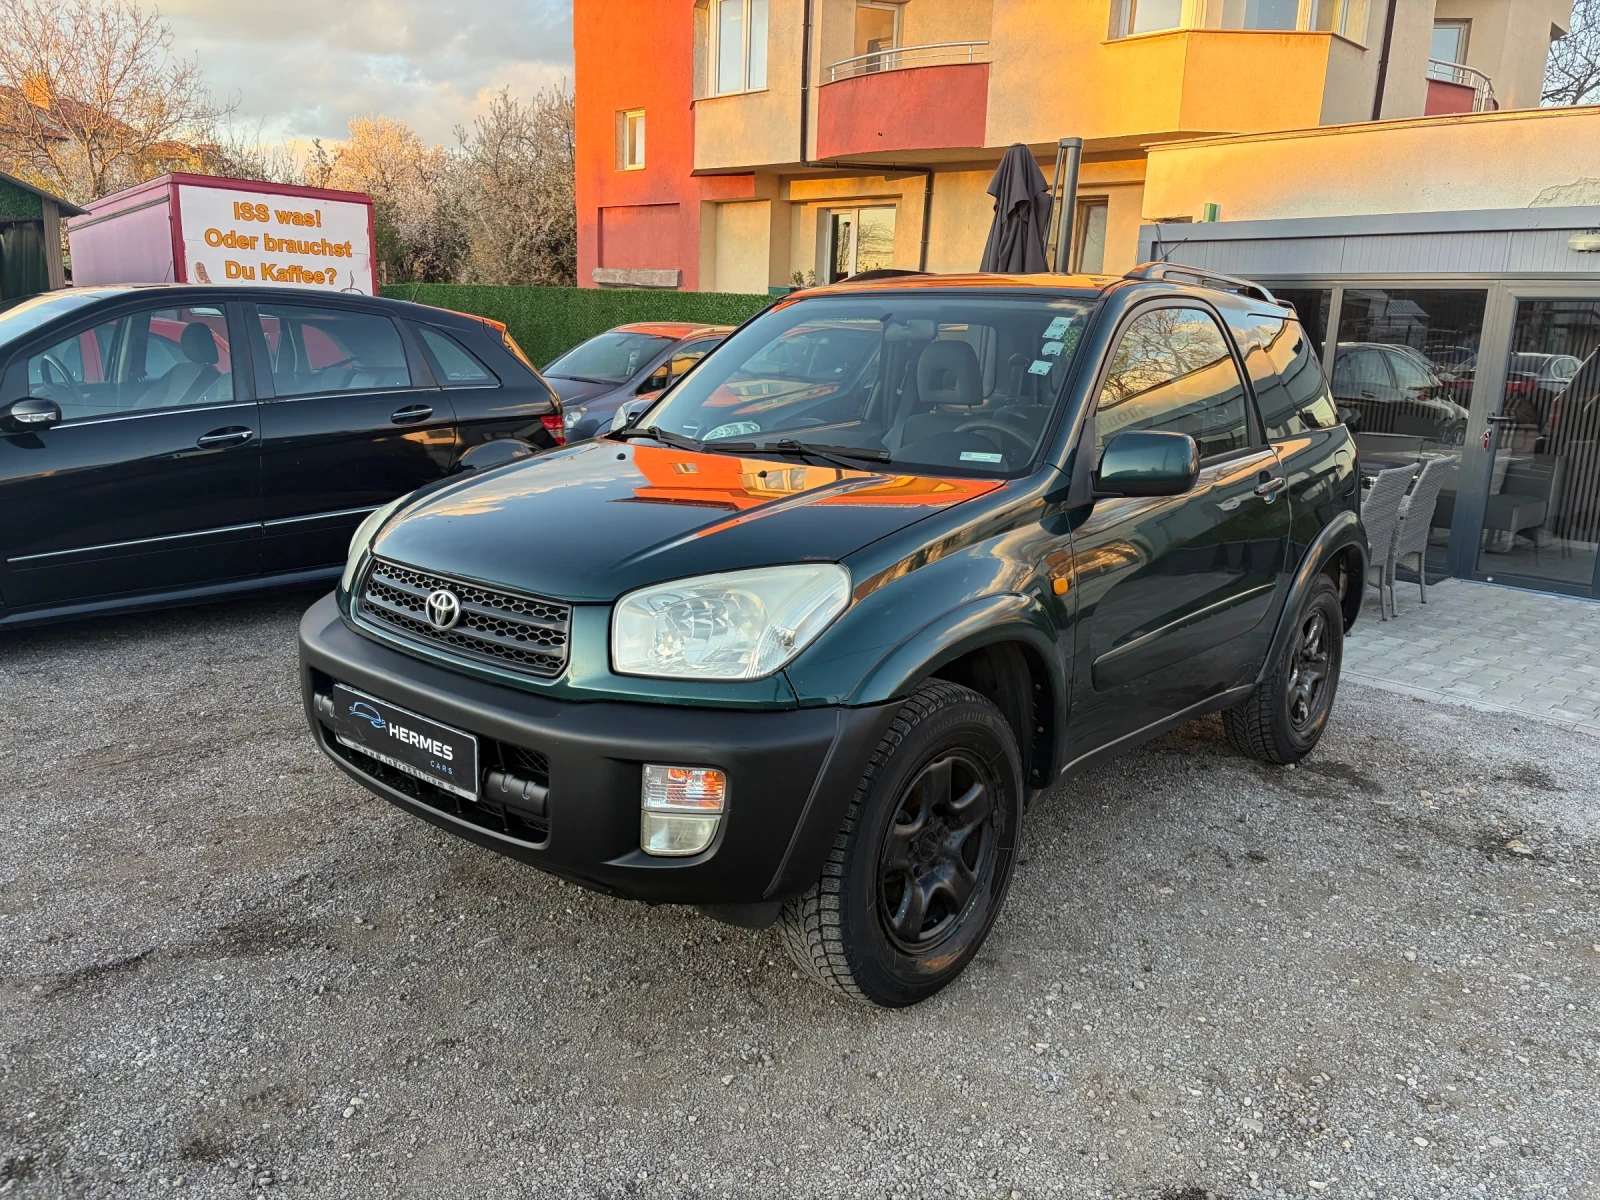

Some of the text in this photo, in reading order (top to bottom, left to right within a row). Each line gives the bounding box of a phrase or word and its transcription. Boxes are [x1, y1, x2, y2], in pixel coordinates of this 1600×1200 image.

[233, 202, 322, 227] ISS was!
[204, 228, 352, 258] Oder brauchst
[225, 260, 337, 285] Du Kaffee?
[388, 722, 453, 761] HERMES
[430, 760, 453, 775] CARS
